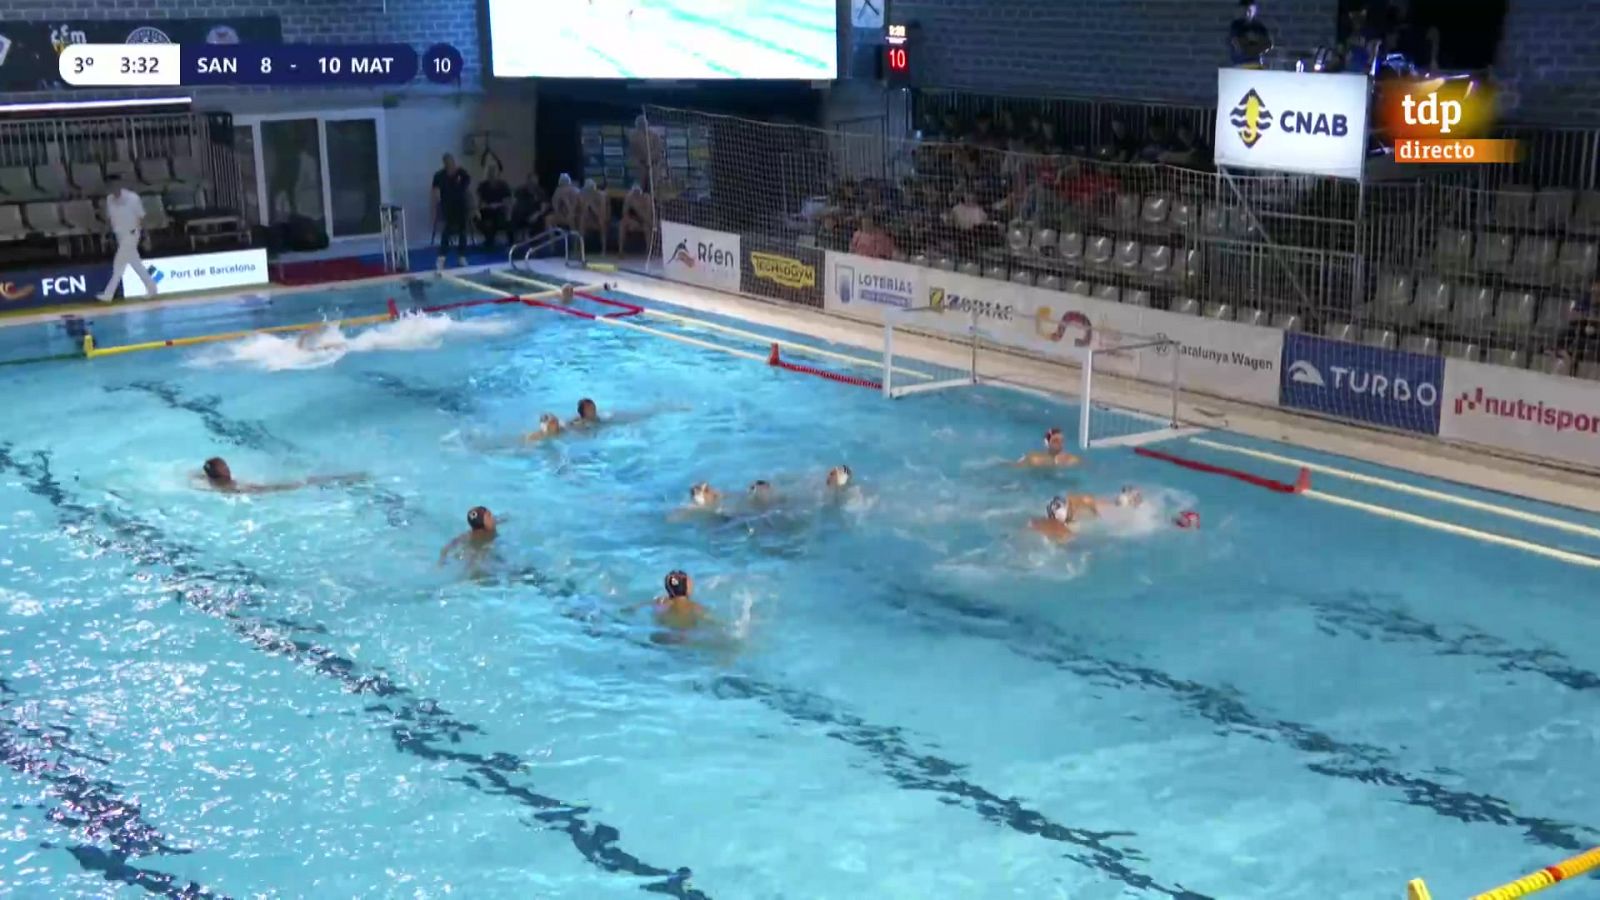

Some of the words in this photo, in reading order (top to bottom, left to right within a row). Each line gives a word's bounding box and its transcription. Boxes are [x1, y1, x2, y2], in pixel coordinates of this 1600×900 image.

[889, 49, 906, 68] 10
[1280, 110, 1349, 138] CNAB
[697, 241, 734, 268] Rfen
[170, 267, 191, 280] Port
[193, 266, 206, 278] de
[208, 261, 257, 276] Barcelona
[42, 274, 87, 296] FCN
[1231, 351, 1274, 371] Wagen
[1329, 366, 1438, 407] TURBO
